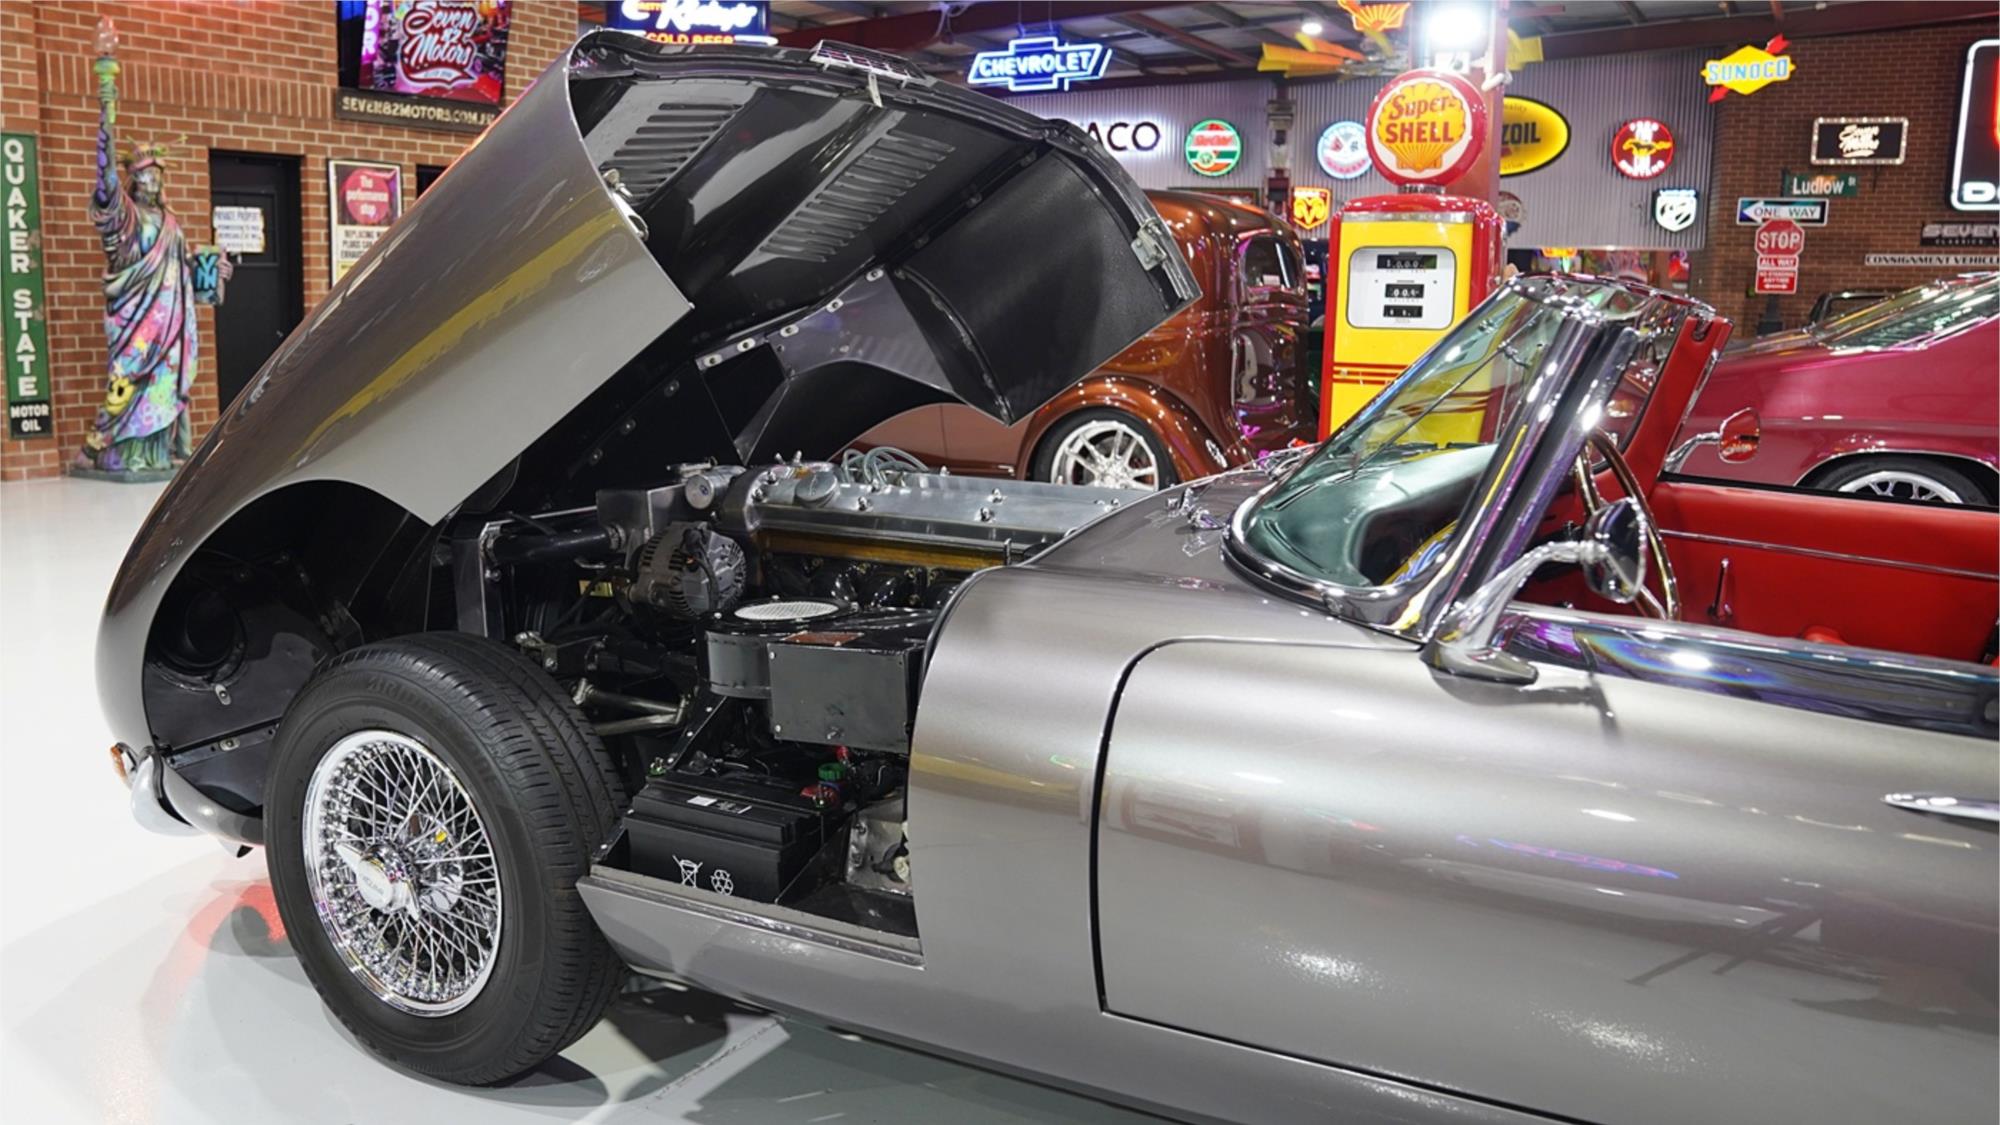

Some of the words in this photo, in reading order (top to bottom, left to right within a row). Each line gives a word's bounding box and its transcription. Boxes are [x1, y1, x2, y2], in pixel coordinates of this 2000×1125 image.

[403, 33, 472, 67] Motors
[978, 51, 1092, 77] CHEVROLET
[1708, 58, 1788, 82] SUNOCO
[1384, 121, 1455, 144] SHELL
[1792, 176, 1845, 195] Ludlow
[4, 139, 31, 274] QUAKER
[1754, 208, 1778, 217] ONE
[1788, 208, 1817, 217] WAY
[1758, 231, 1801, 249] STOP
[13, 289, 38, 397] STATE
[11, 404, 49, 418] MOTOR
[21, 419, 41, 432] OIL
